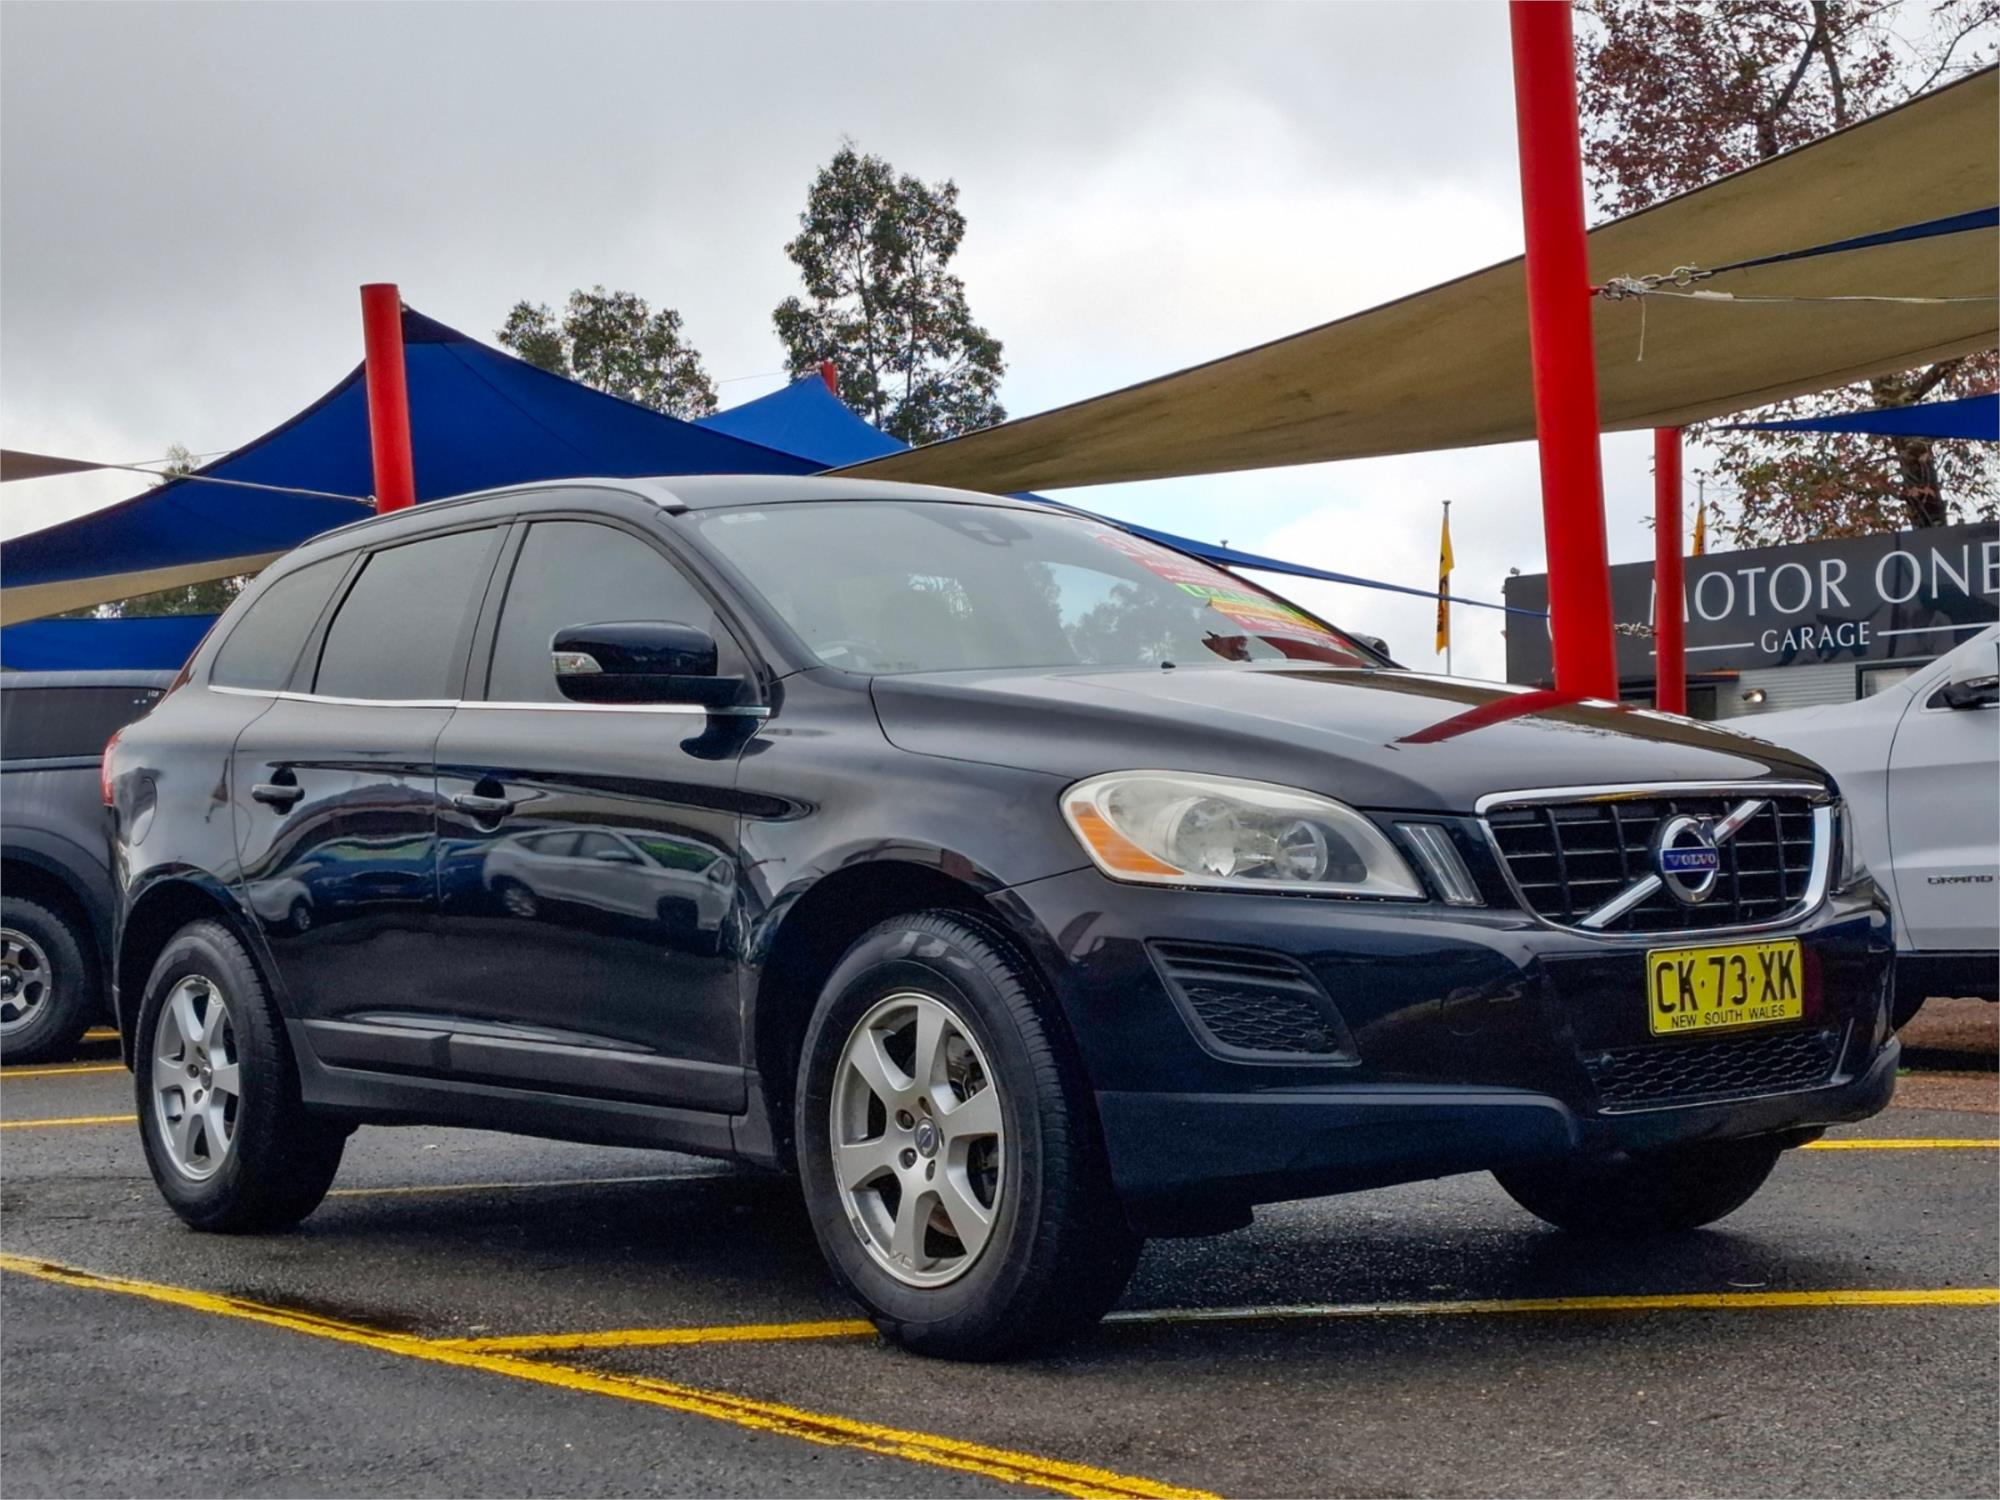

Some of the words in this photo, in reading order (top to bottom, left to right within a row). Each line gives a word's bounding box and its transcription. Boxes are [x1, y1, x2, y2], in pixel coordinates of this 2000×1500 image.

[1761, 621, 1871, 654] GARAGE
[1665, 853, 1716, 867] VOLVO
[1927, 876, 1993, 885] GRAND
[1671, 1014, 1697, 1029] NEW
[1704, 1008, 1743, 1025] SOUTH
[1749, 1004, 1786, 1020] WALES
